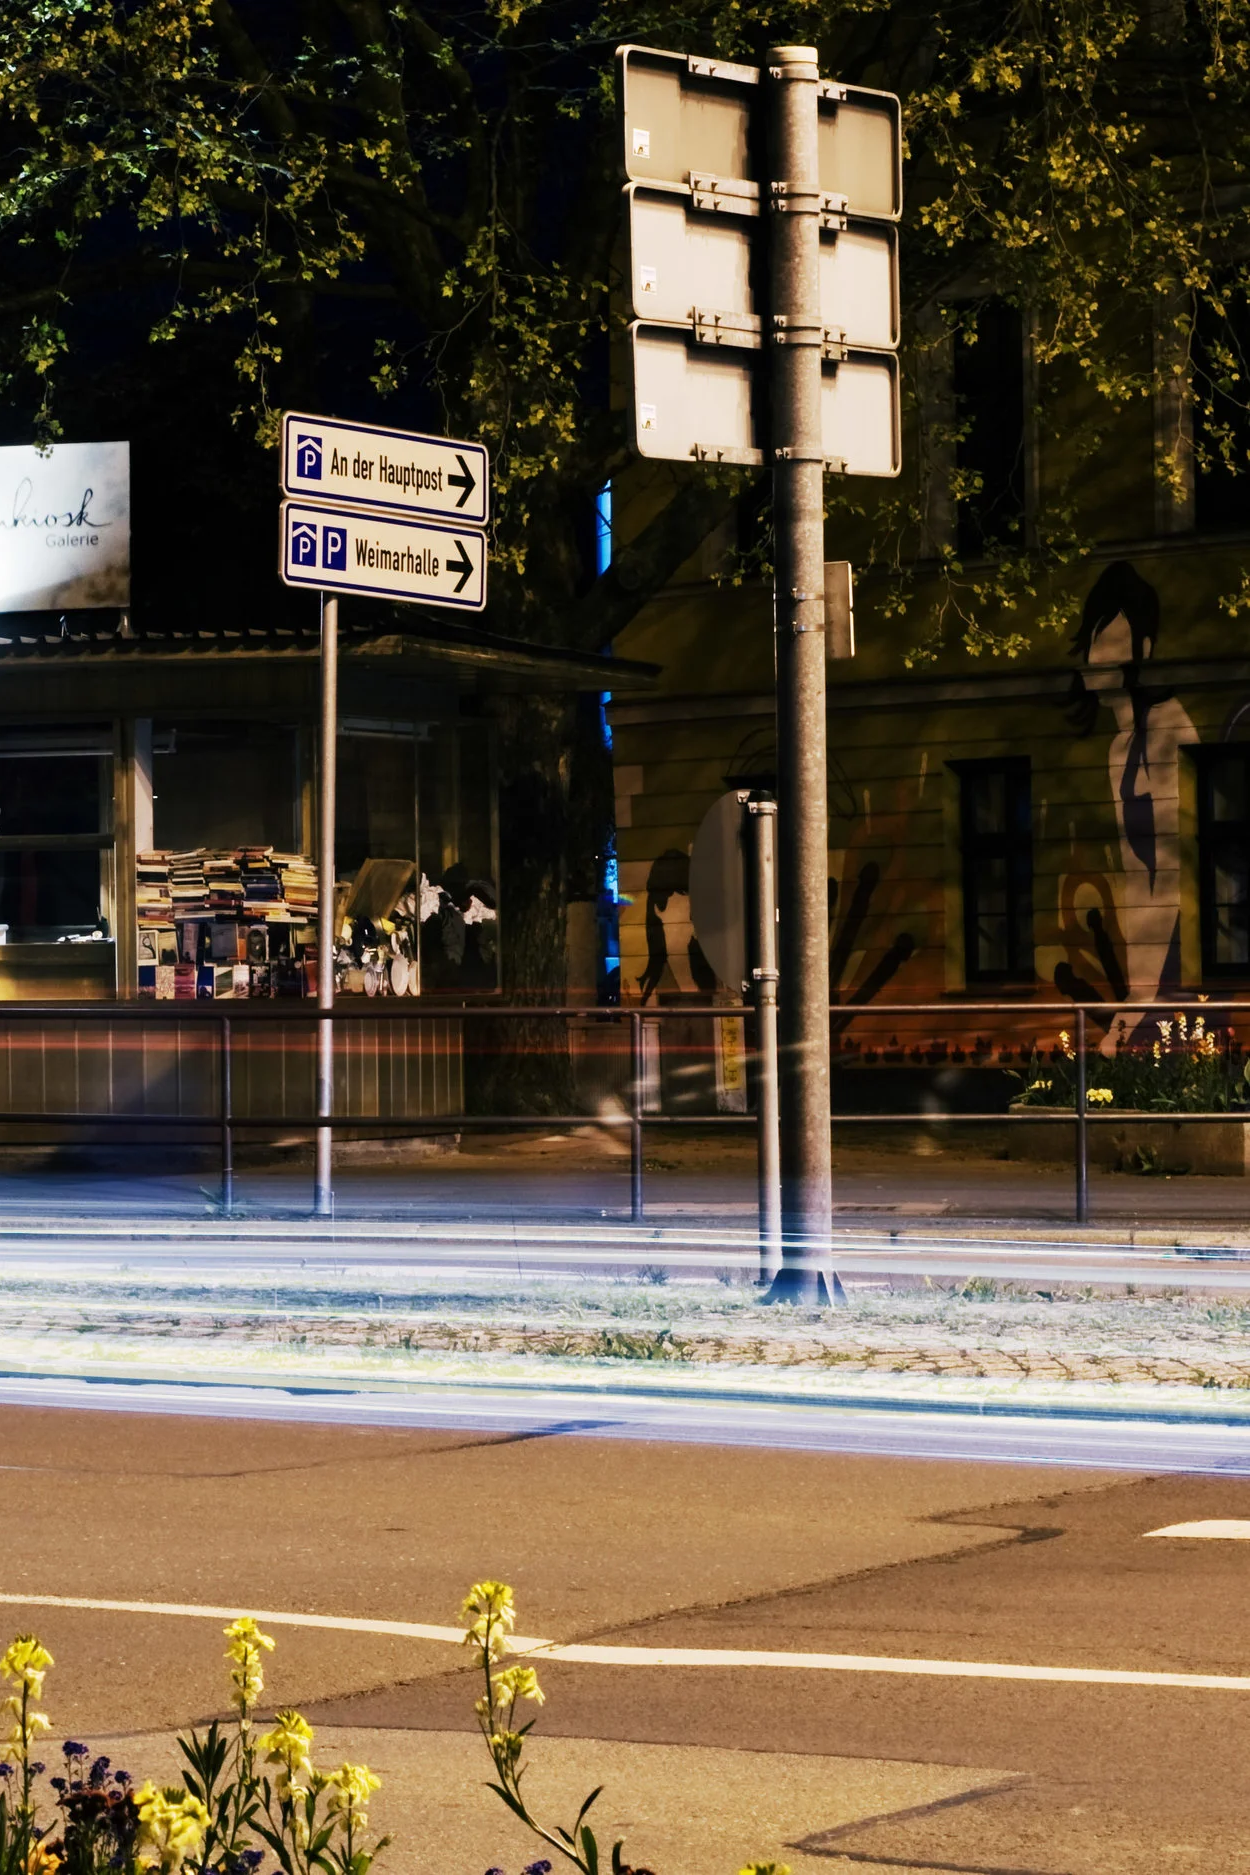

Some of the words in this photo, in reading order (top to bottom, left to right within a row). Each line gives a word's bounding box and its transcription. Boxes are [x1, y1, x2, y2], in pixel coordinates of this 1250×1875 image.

[331, 448, 348, 477] An
[353, 451, 374, 481] der
[379, 455, 443, 496] Hauptpost
[45, 533, 99, 548] Galerie
[355, 538, 439, 578] Weimarhalle
